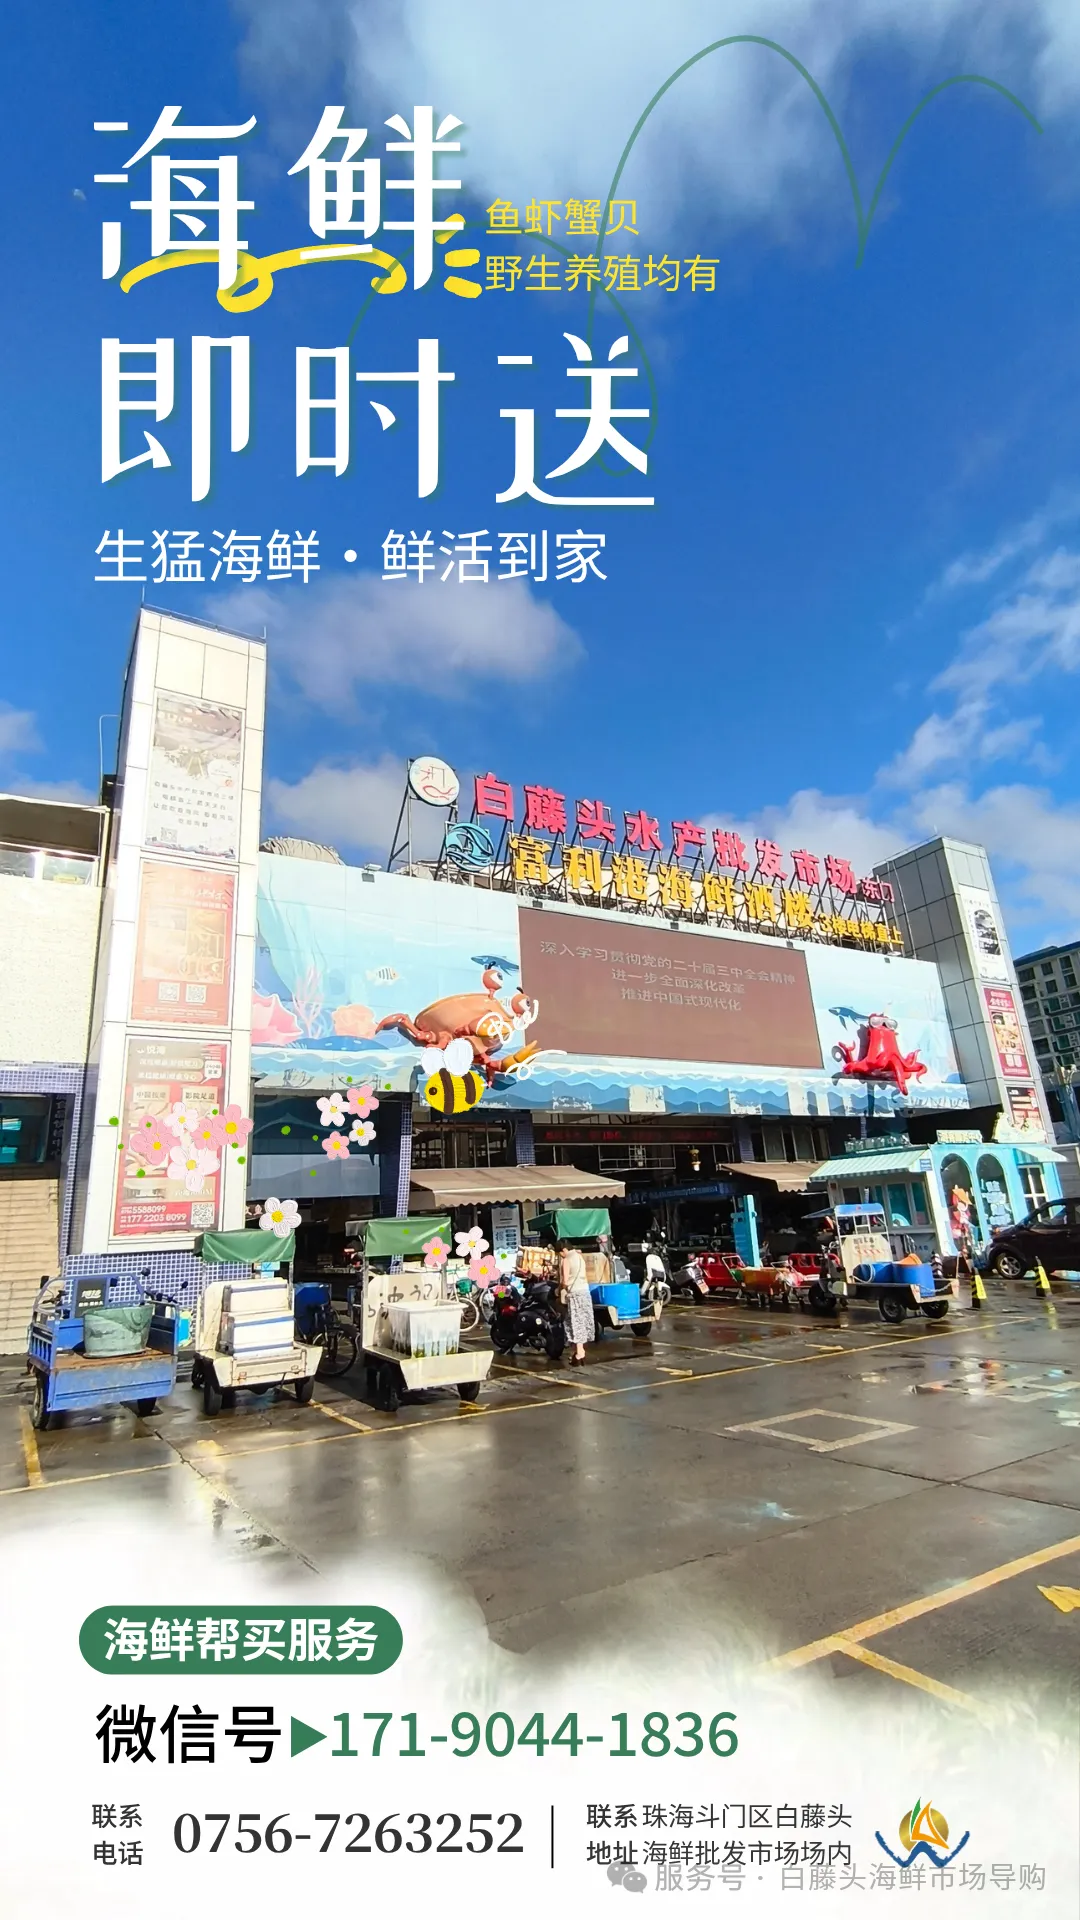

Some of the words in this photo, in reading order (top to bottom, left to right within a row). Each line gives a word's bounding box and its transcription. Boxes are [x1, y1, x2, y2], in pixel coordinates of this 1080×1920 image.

[474, 771, 858, 895] 白藤头水产批发市场
[861, 875, 896, 903] 东门
[510, 835, 815, 931] 富利港海鲜酒楼
[818, 914, 905, 946] 3楼电梯直上
[540, 940, 797, 985] 深入学习贯彻党的二十届三中全会精神
[611, 968, 746, 995] 进一步全面深化改革
[620, 987, 742, 1012] 推进中国式现代化
